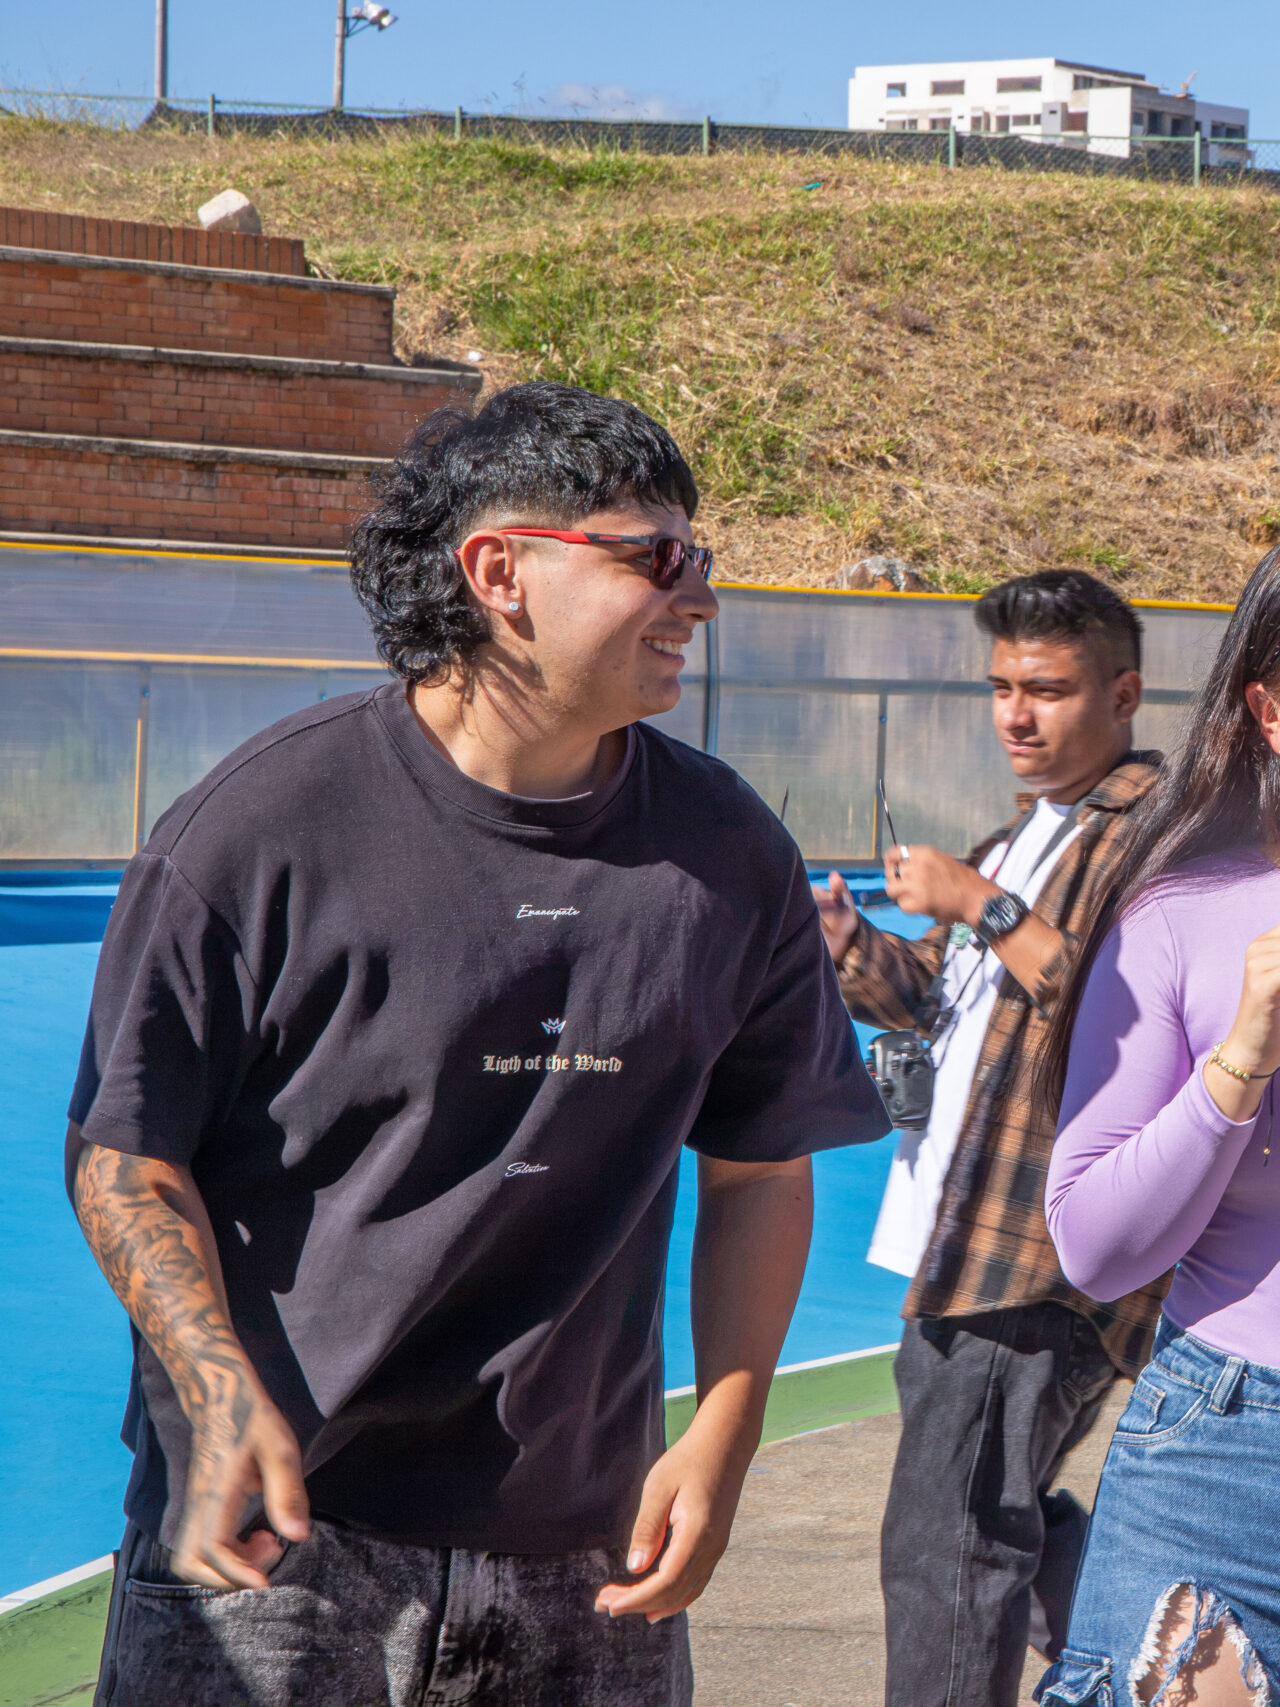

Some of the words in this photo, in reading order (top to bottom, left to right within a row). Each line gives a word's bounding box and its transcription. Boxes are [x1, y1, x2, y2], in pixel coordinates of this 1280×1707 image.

[482, 1055, 521, 1074] Ligth
[524, 1055, 542, 1071] of
[545, 1054, 570, 1073] the
[574, 1054, 623, 1073] World
